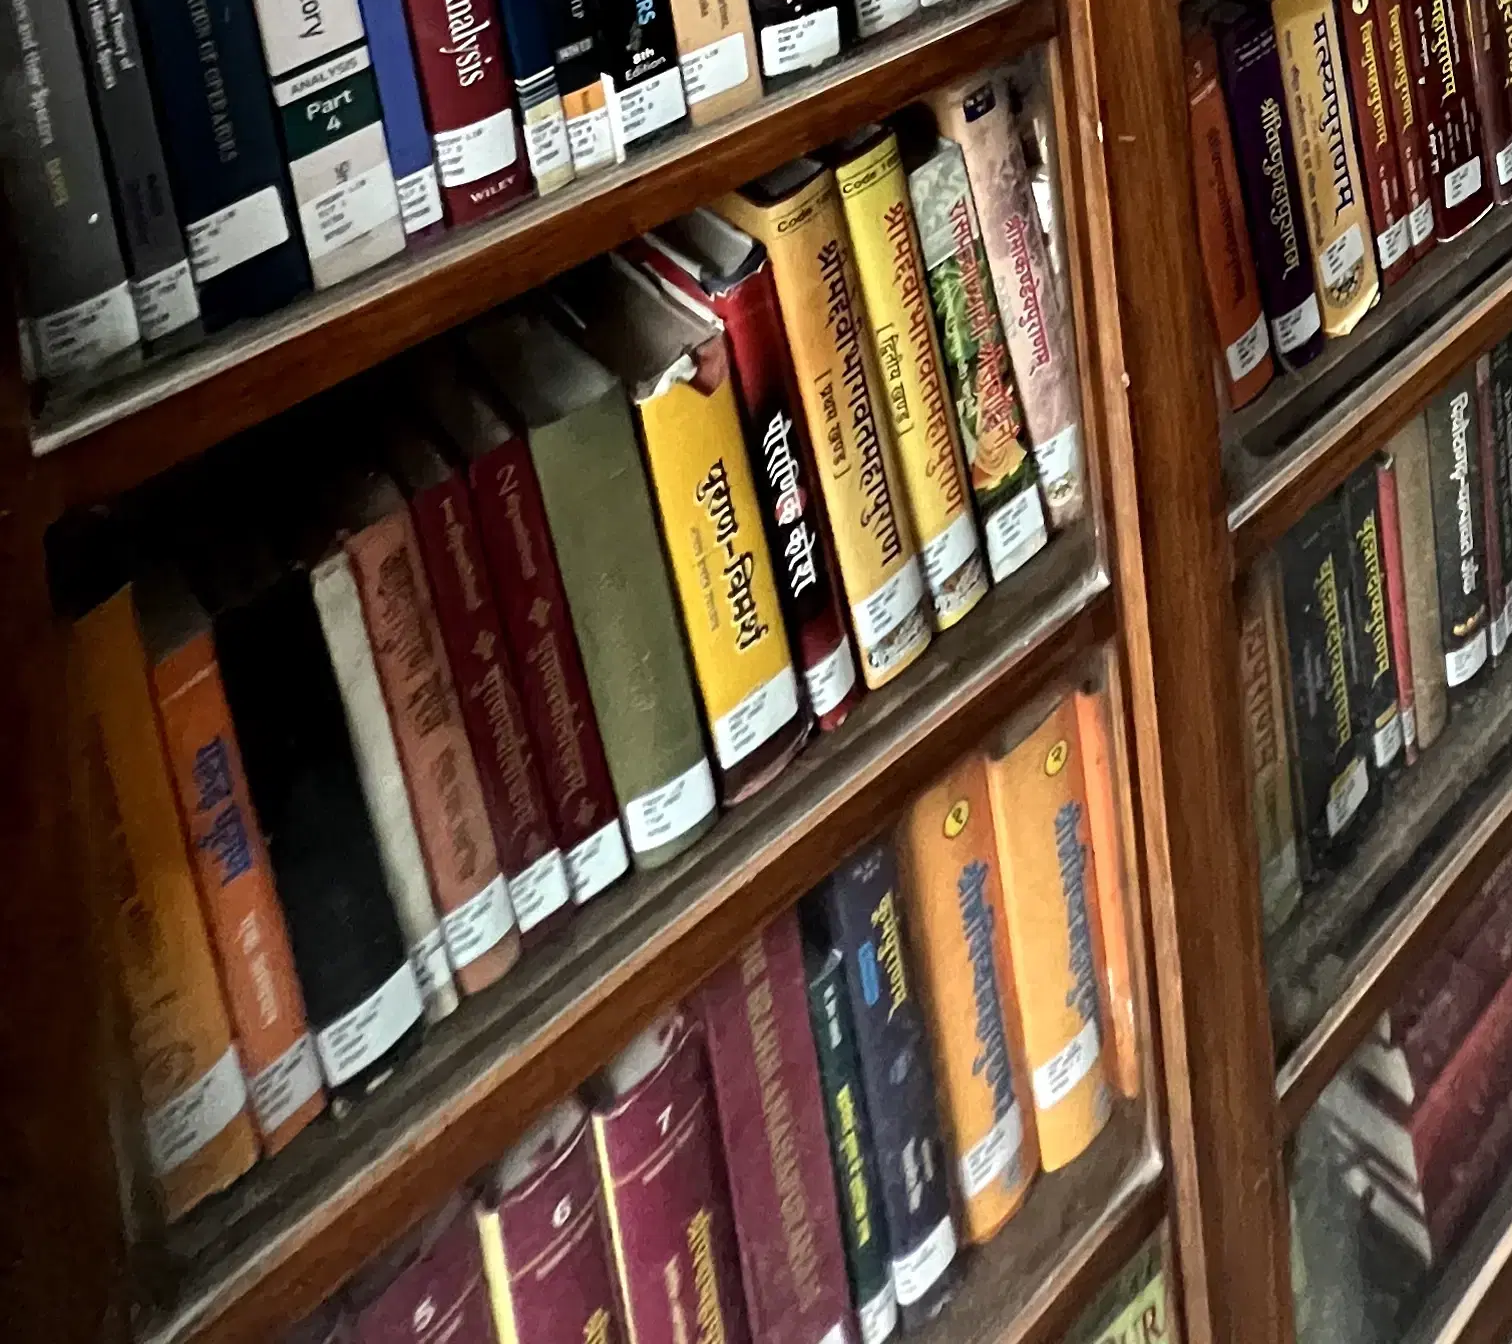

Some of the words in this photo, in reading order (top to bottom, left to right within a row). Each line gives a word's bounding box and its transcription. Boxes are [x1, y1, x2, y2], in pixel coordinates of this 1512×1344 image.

[624, 60, 666, 81] Edition
[632, 46, 655, 67] 8th
[304, 89, 354, 124] Part
[1314, 13, 1356, 226] मत्स्यपुराणम्
[326, 114, 343, 134] 4
[468, 177, 519, 205] WILEY
[842, 174, 875, 194] Code
[694, 457, 769, 652] पुराण-विमर्श
[785, 521, 818, 598] कोश
